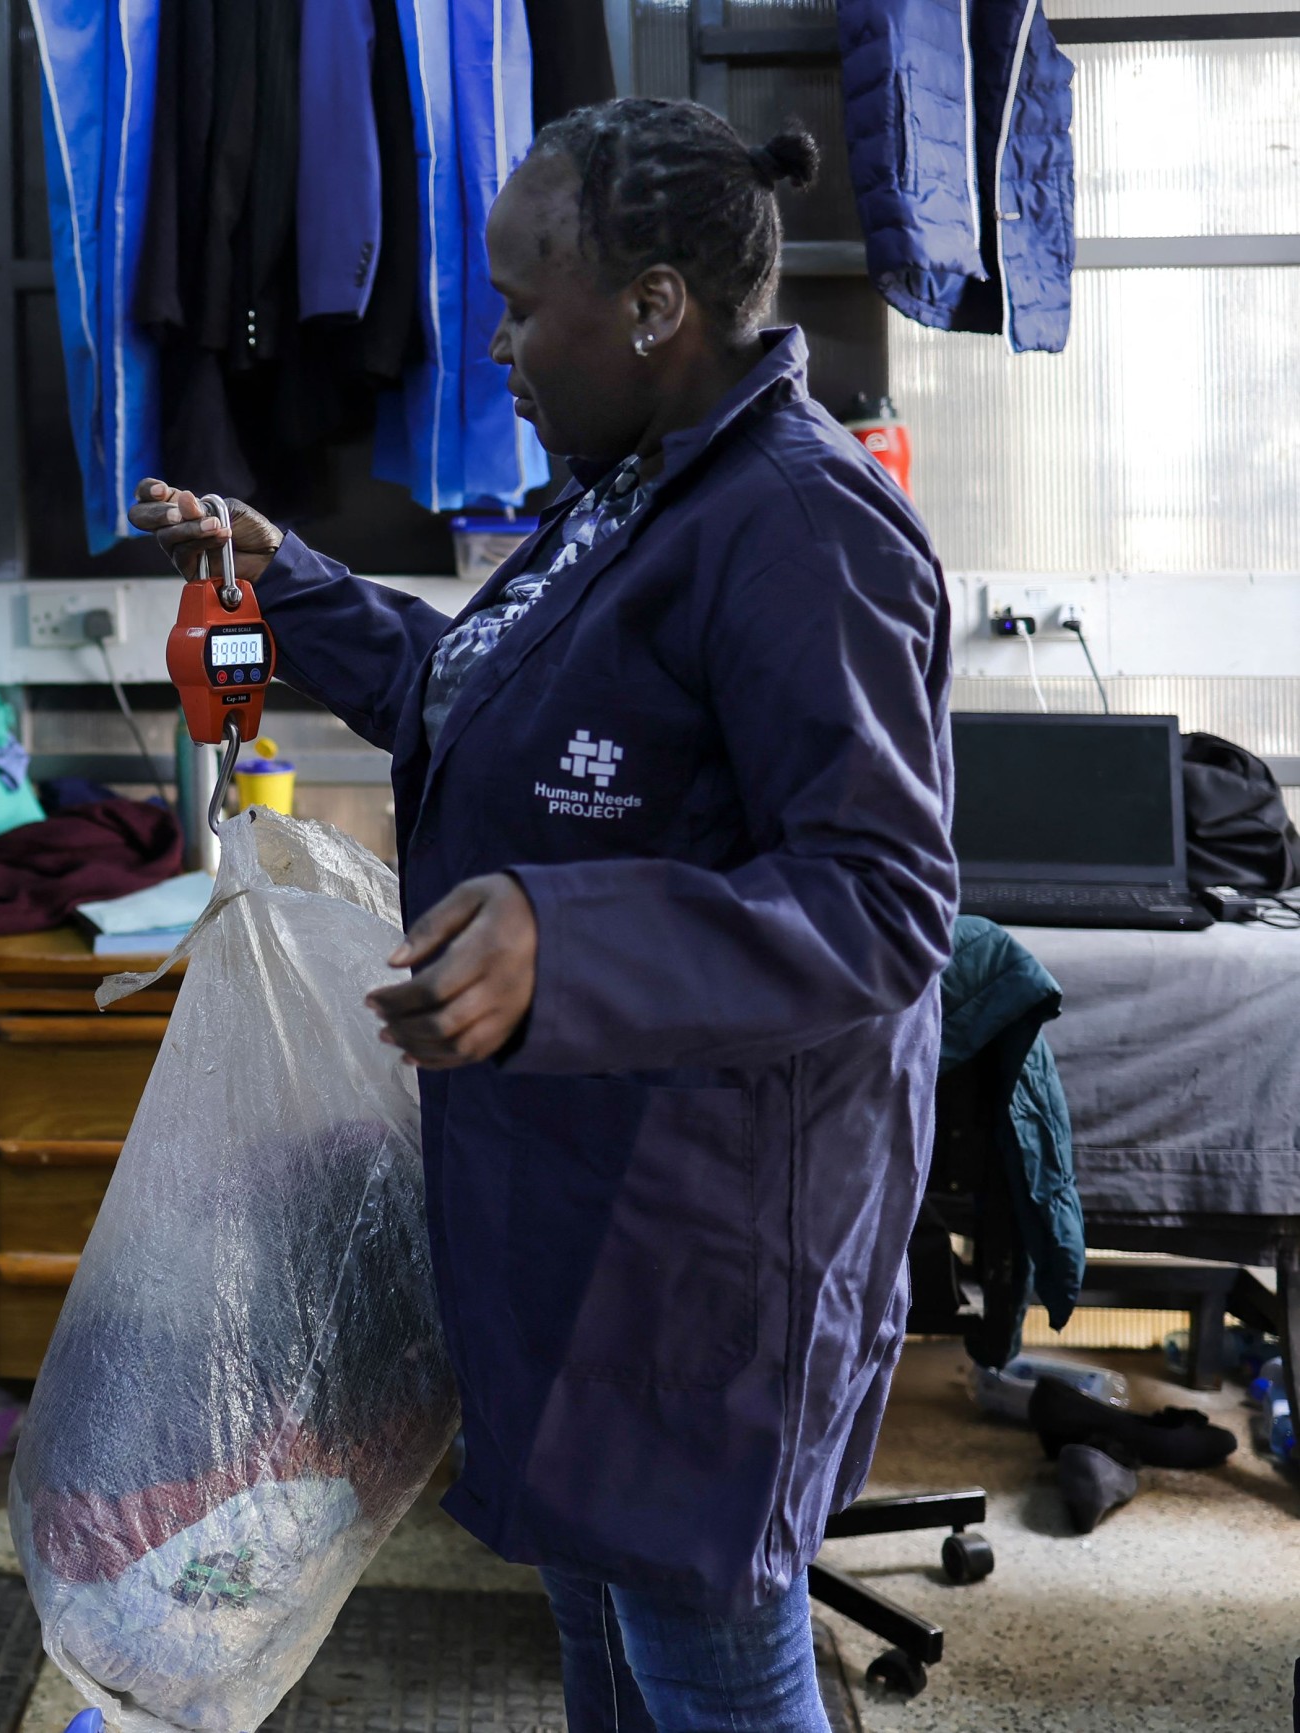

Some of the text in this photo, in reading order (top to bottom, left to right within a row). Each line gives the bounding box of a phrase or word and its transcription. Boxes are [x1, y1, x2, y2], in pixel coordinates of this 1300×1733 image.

[534, 781, 642, 807] Human Needs
[548, 800, 626, 819] PROJECT
